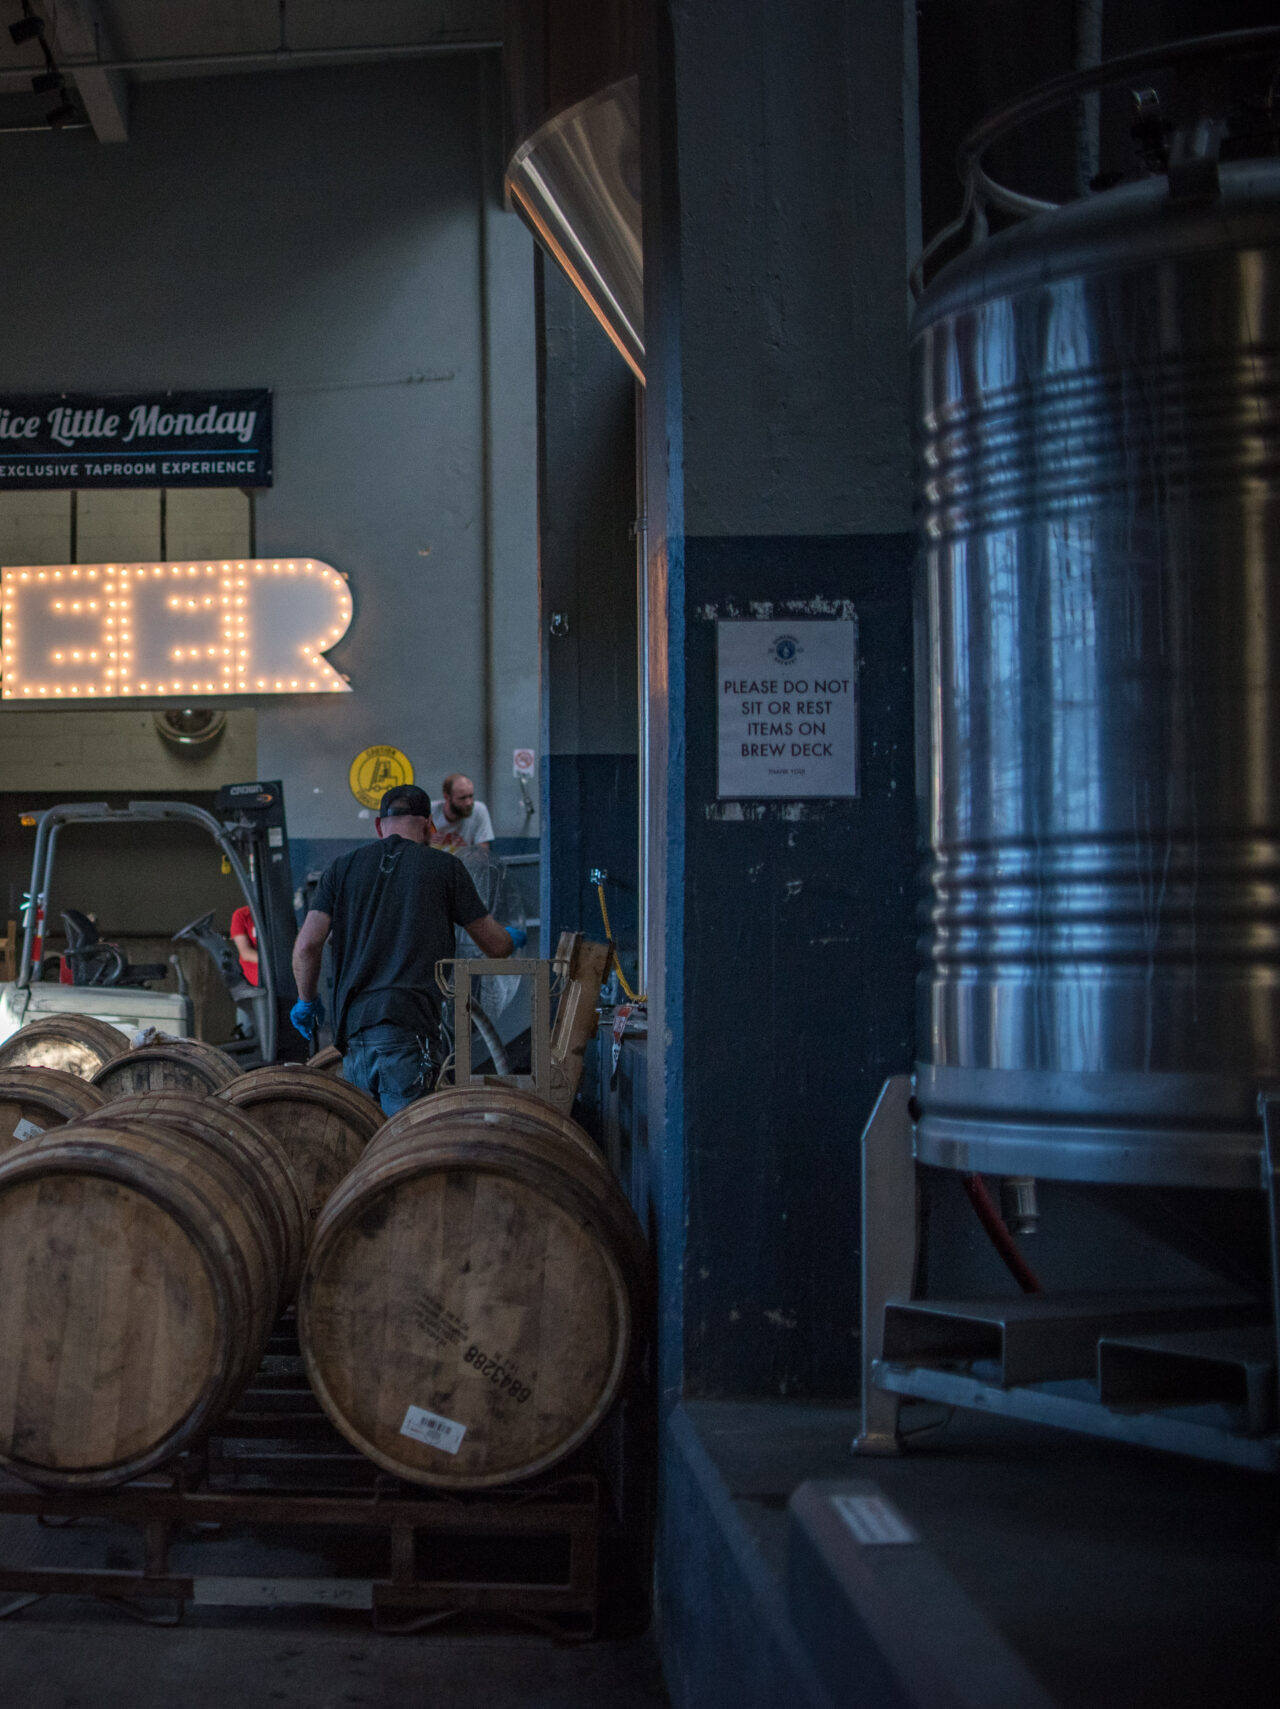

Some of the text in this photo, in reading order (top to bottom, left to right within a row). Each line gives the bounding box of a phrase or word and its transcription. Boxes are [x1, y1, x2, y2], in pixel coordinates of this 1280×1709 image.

[47, 405, 119, 447] Little
[122, 404, 257, 444] Monday
[84, 463, 156, 476] TAPROOM
[162, 461, 257, 475] EXPERIENCE
[723, 680, 850, 694] PLEASE DO NOT
[741, 701, 832, 715] SIT OR REST
[747, 722, 826, 736] ITEMS ON
[740, 743, 833, 758] BREW DECK
[464, 1346, 532, 1404] 6843288
